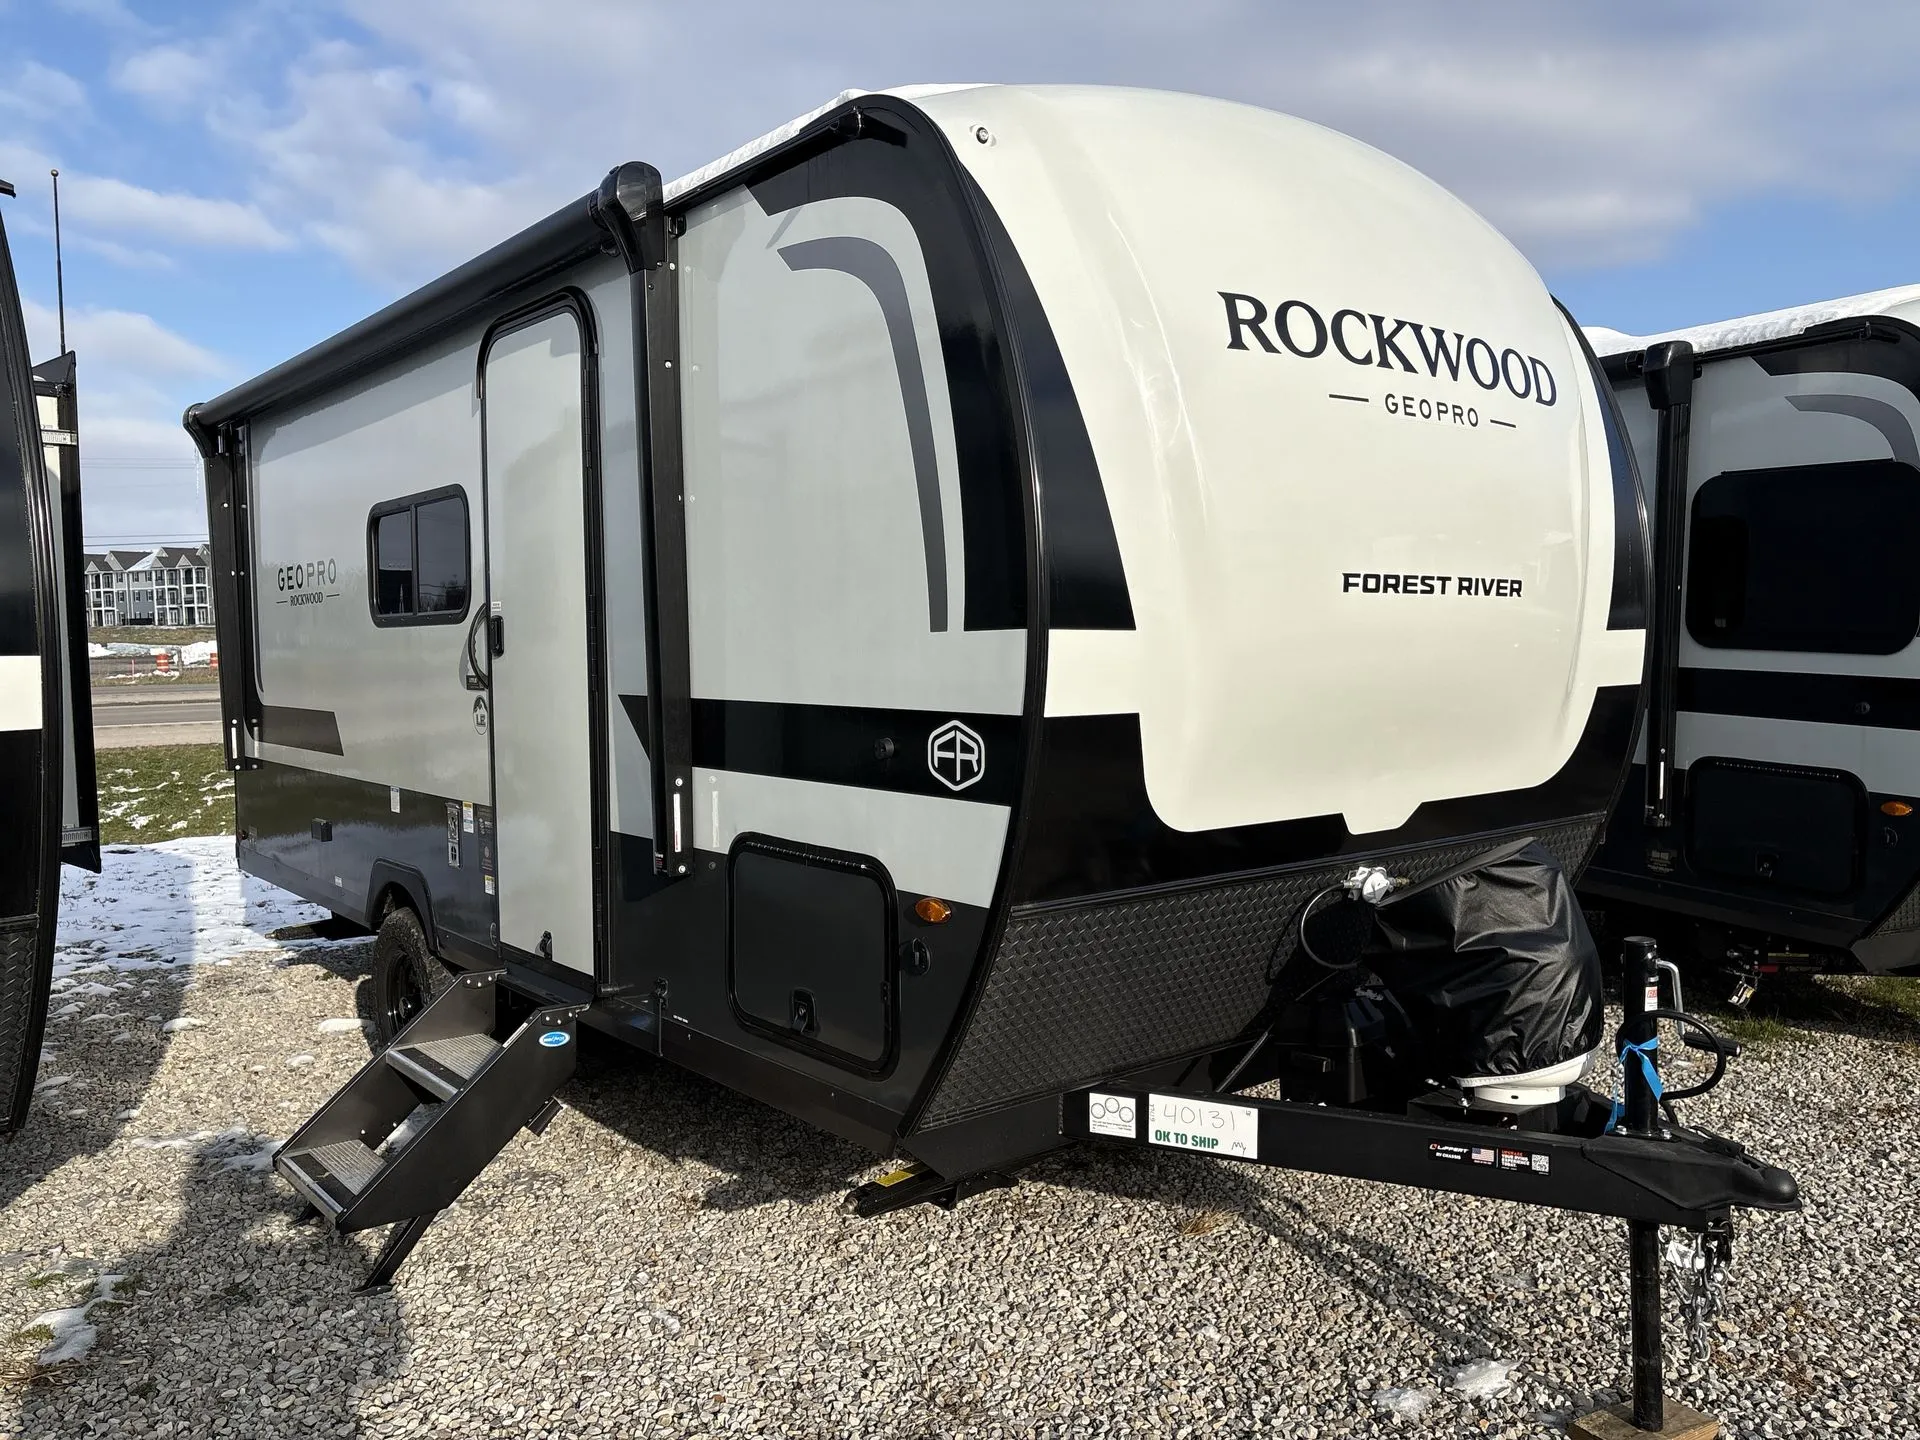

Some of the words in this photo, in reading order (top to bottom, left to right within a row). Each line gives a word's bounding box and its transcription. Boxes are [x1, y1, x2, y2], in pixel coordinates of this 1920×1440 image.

[1217, 291, 1557, 407] ROCKWOOD
[1385, 394, 1479, 427] GEOPRO
[278, 558, 336, 591] GEOPRO
[1342, 573, 1452, 595] FOREST
[1457, 577, 1523, 598] RIVER
[290, 592, 323, 606] ROCKWOOD
[1164, 1104, 1235, 1130] 40131
[1155, 1129, 1170, 1143] OK
[1174, 1132, 1188, 1145] TO
[1191, 1135, 1219, 1150] SHIP
[1437, 1145, 1469, 1154] LIPPERT
